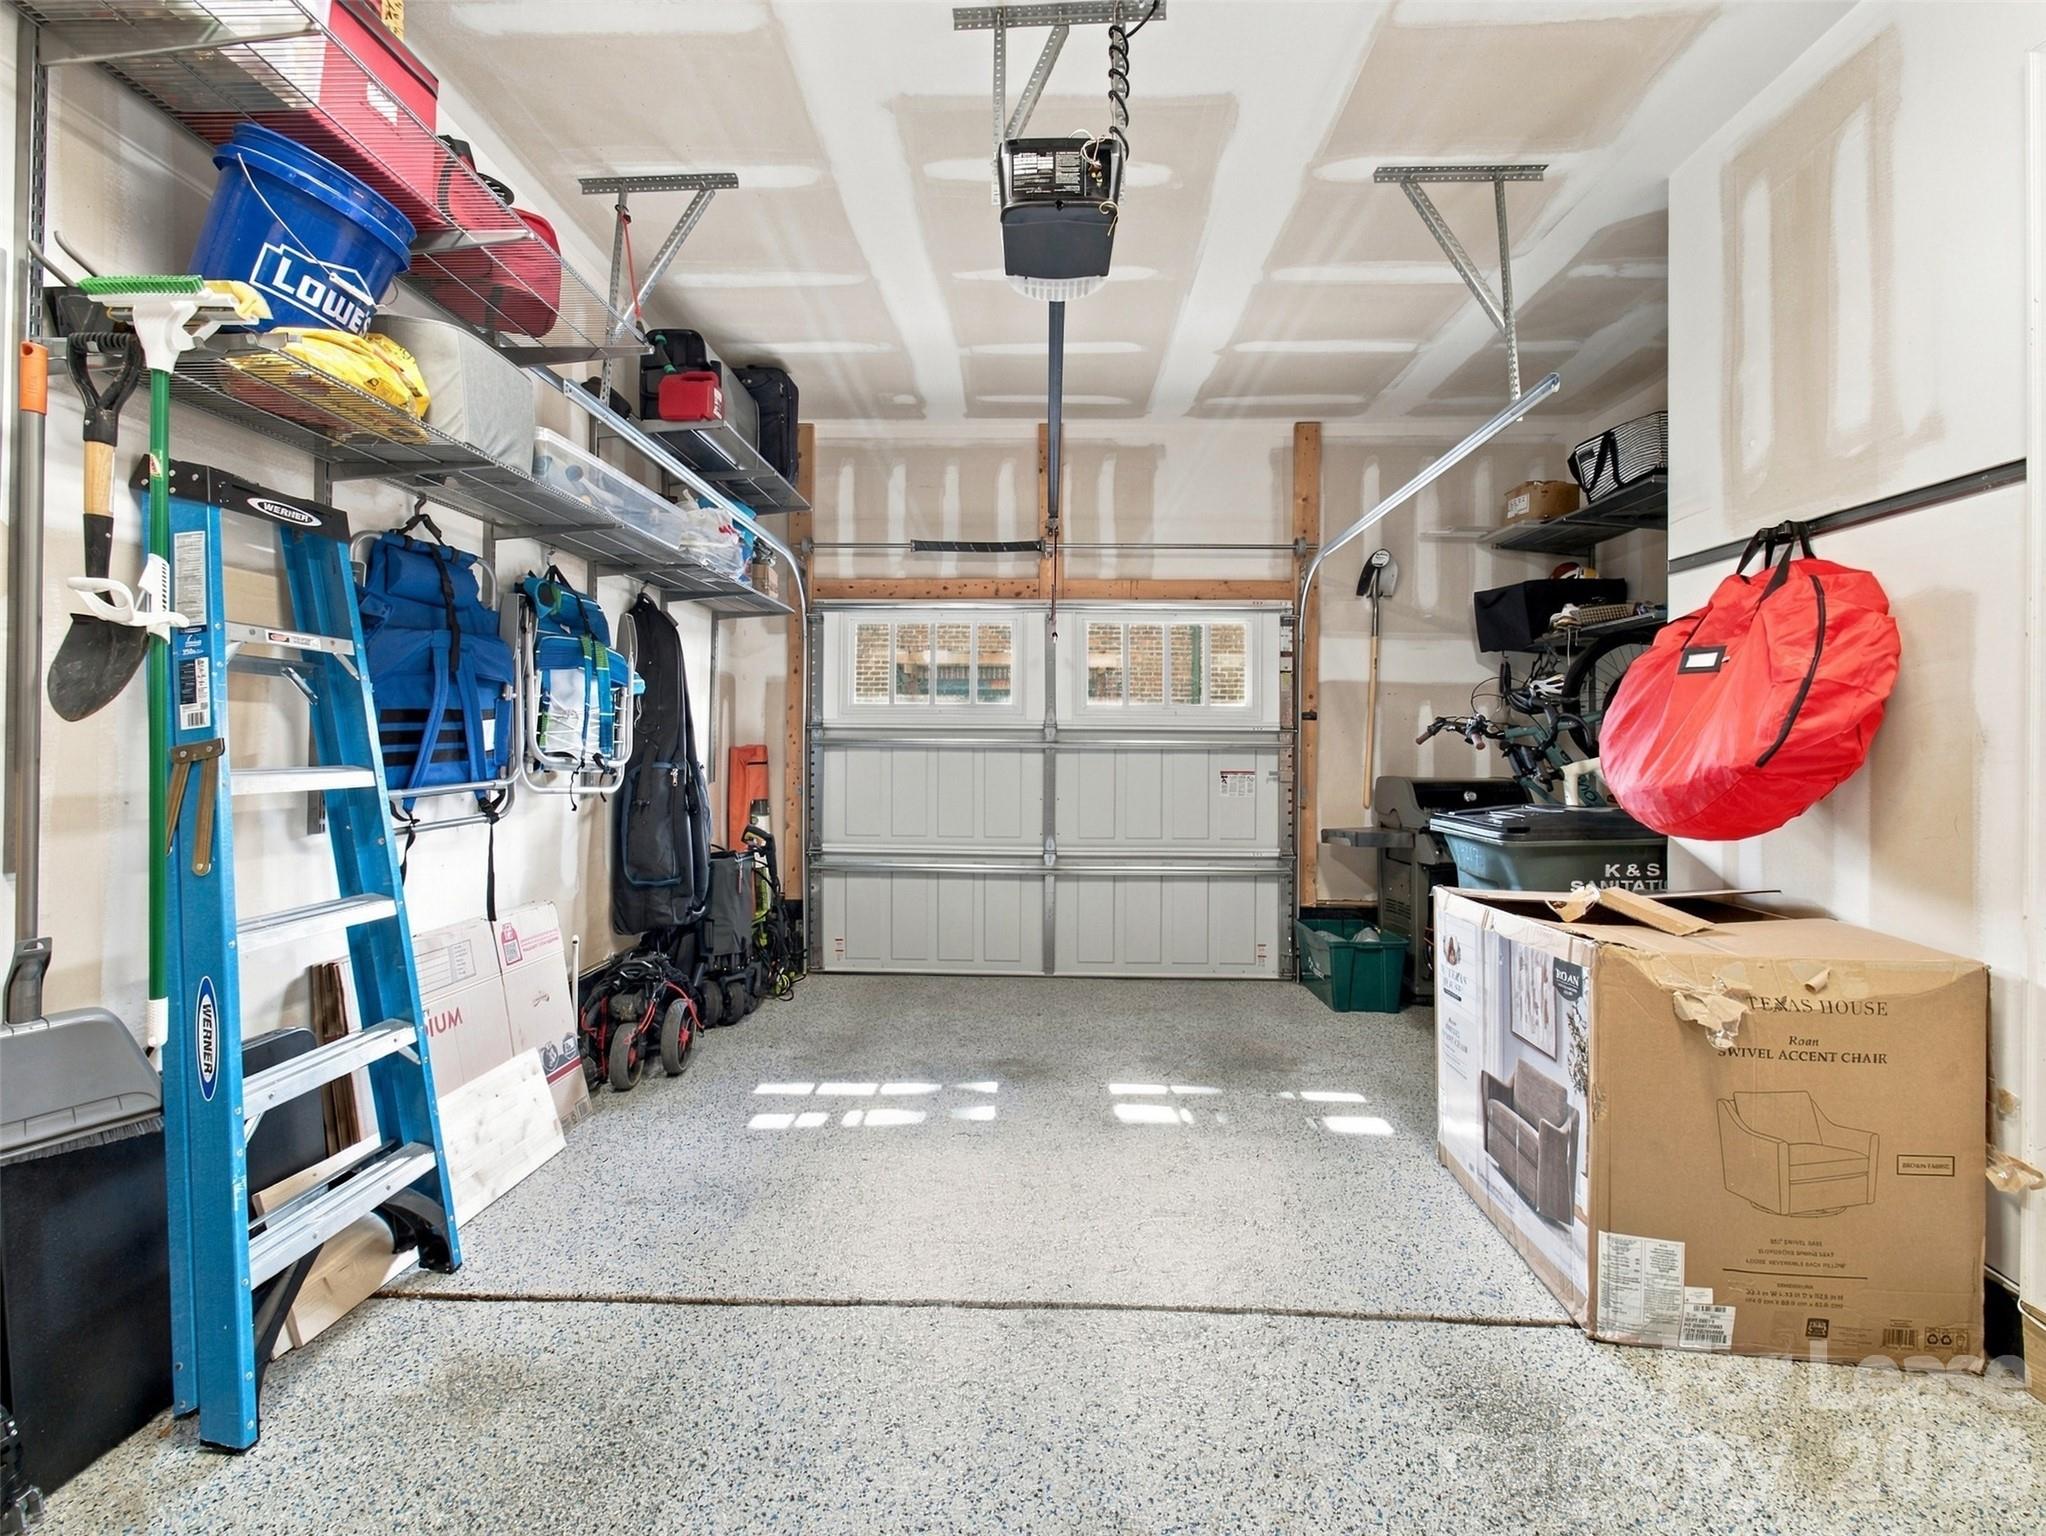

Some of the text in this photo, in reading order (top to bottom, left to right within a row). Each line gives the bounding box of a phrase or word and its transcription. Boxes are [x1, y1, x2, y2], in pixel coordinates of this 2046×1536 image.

[272, 256, 371, 338] LOWE'S
[263, 502, 309, 522] WERNER
[1605, 863, 1660, 877] K & S
[1745, 995, 1888, 1016] TEXAS HOUSE
[202, 1003, 213, 1074] WERNER
[1788, 1035, 1820, 1047] Roan
[1717, 1046, 1888, 1064] SWIVEL ACCENT CHAIR
